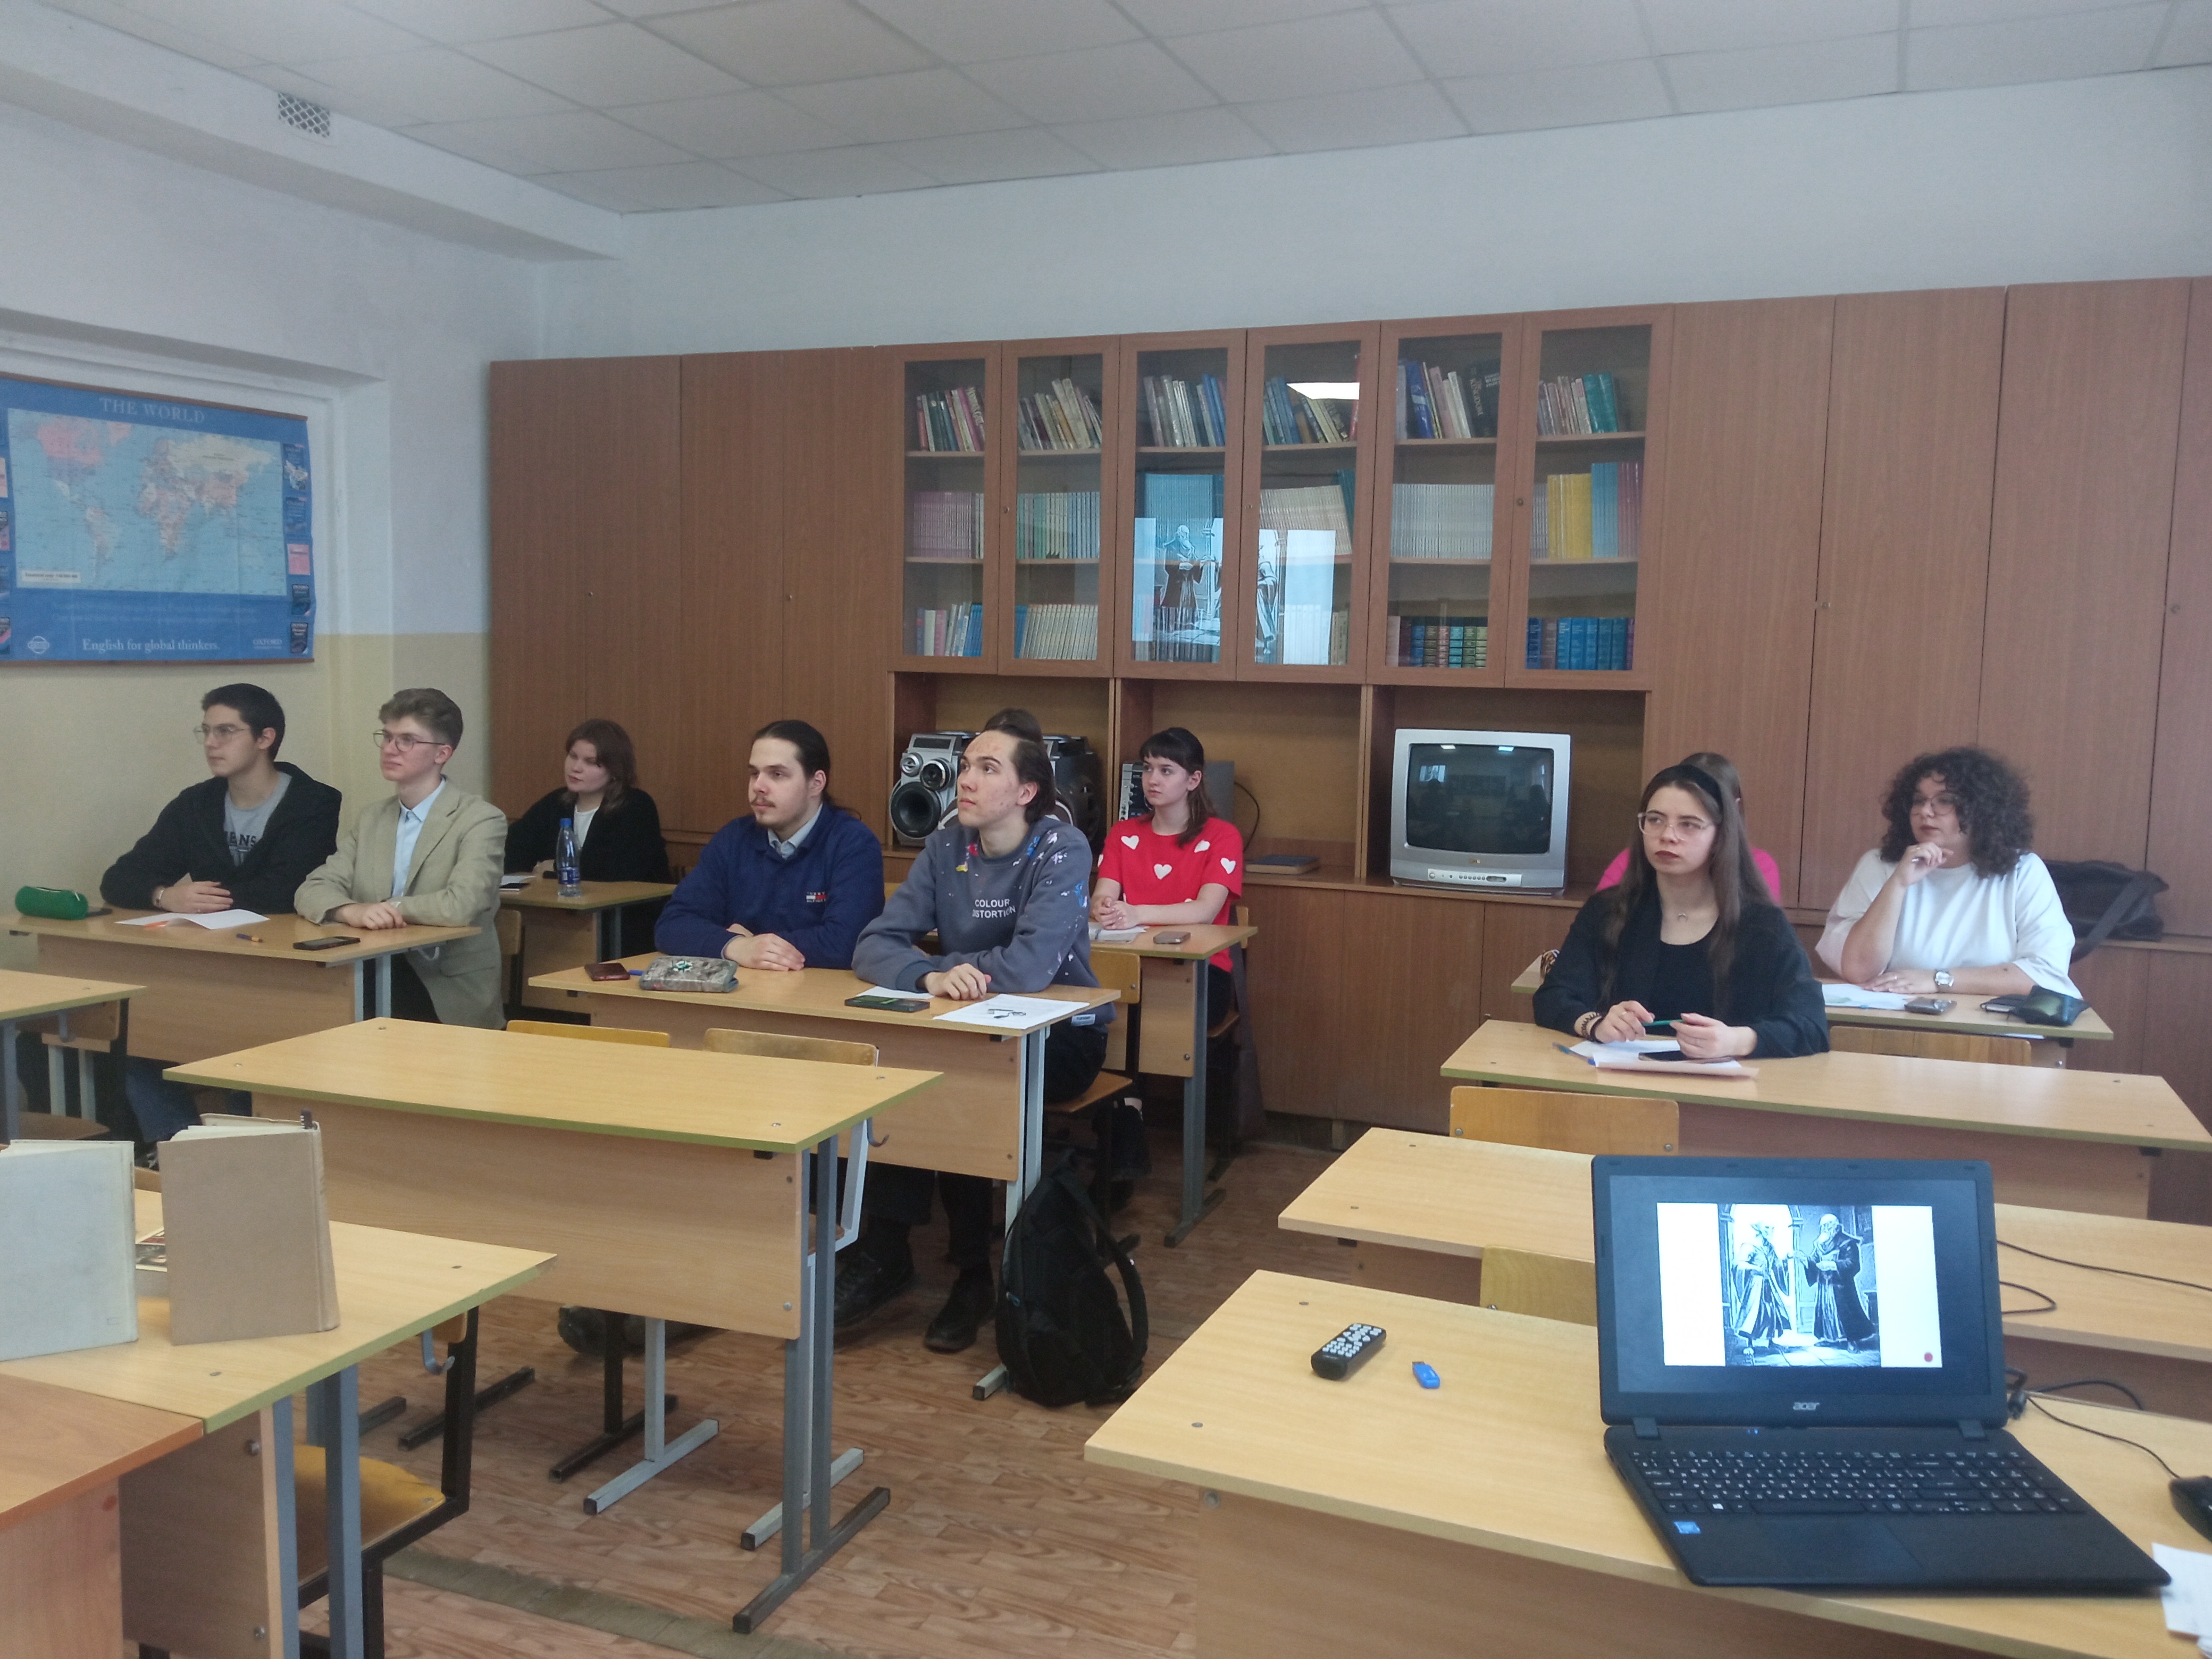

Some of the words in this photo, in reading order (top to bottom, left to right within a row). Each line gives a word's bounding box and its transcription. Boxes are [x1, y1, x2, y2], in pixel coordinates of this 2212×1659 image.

[99, 397, 137, 415] THE
[142, 403, 205, 423] WORLD
[82, 638, 124, 654] English
[127, 639, 141, 650] for
[145, 639, 175, 654] global
[975, 899, 1010, 908] COLOUR
[1792, 1402, 1820, 1410] acer
